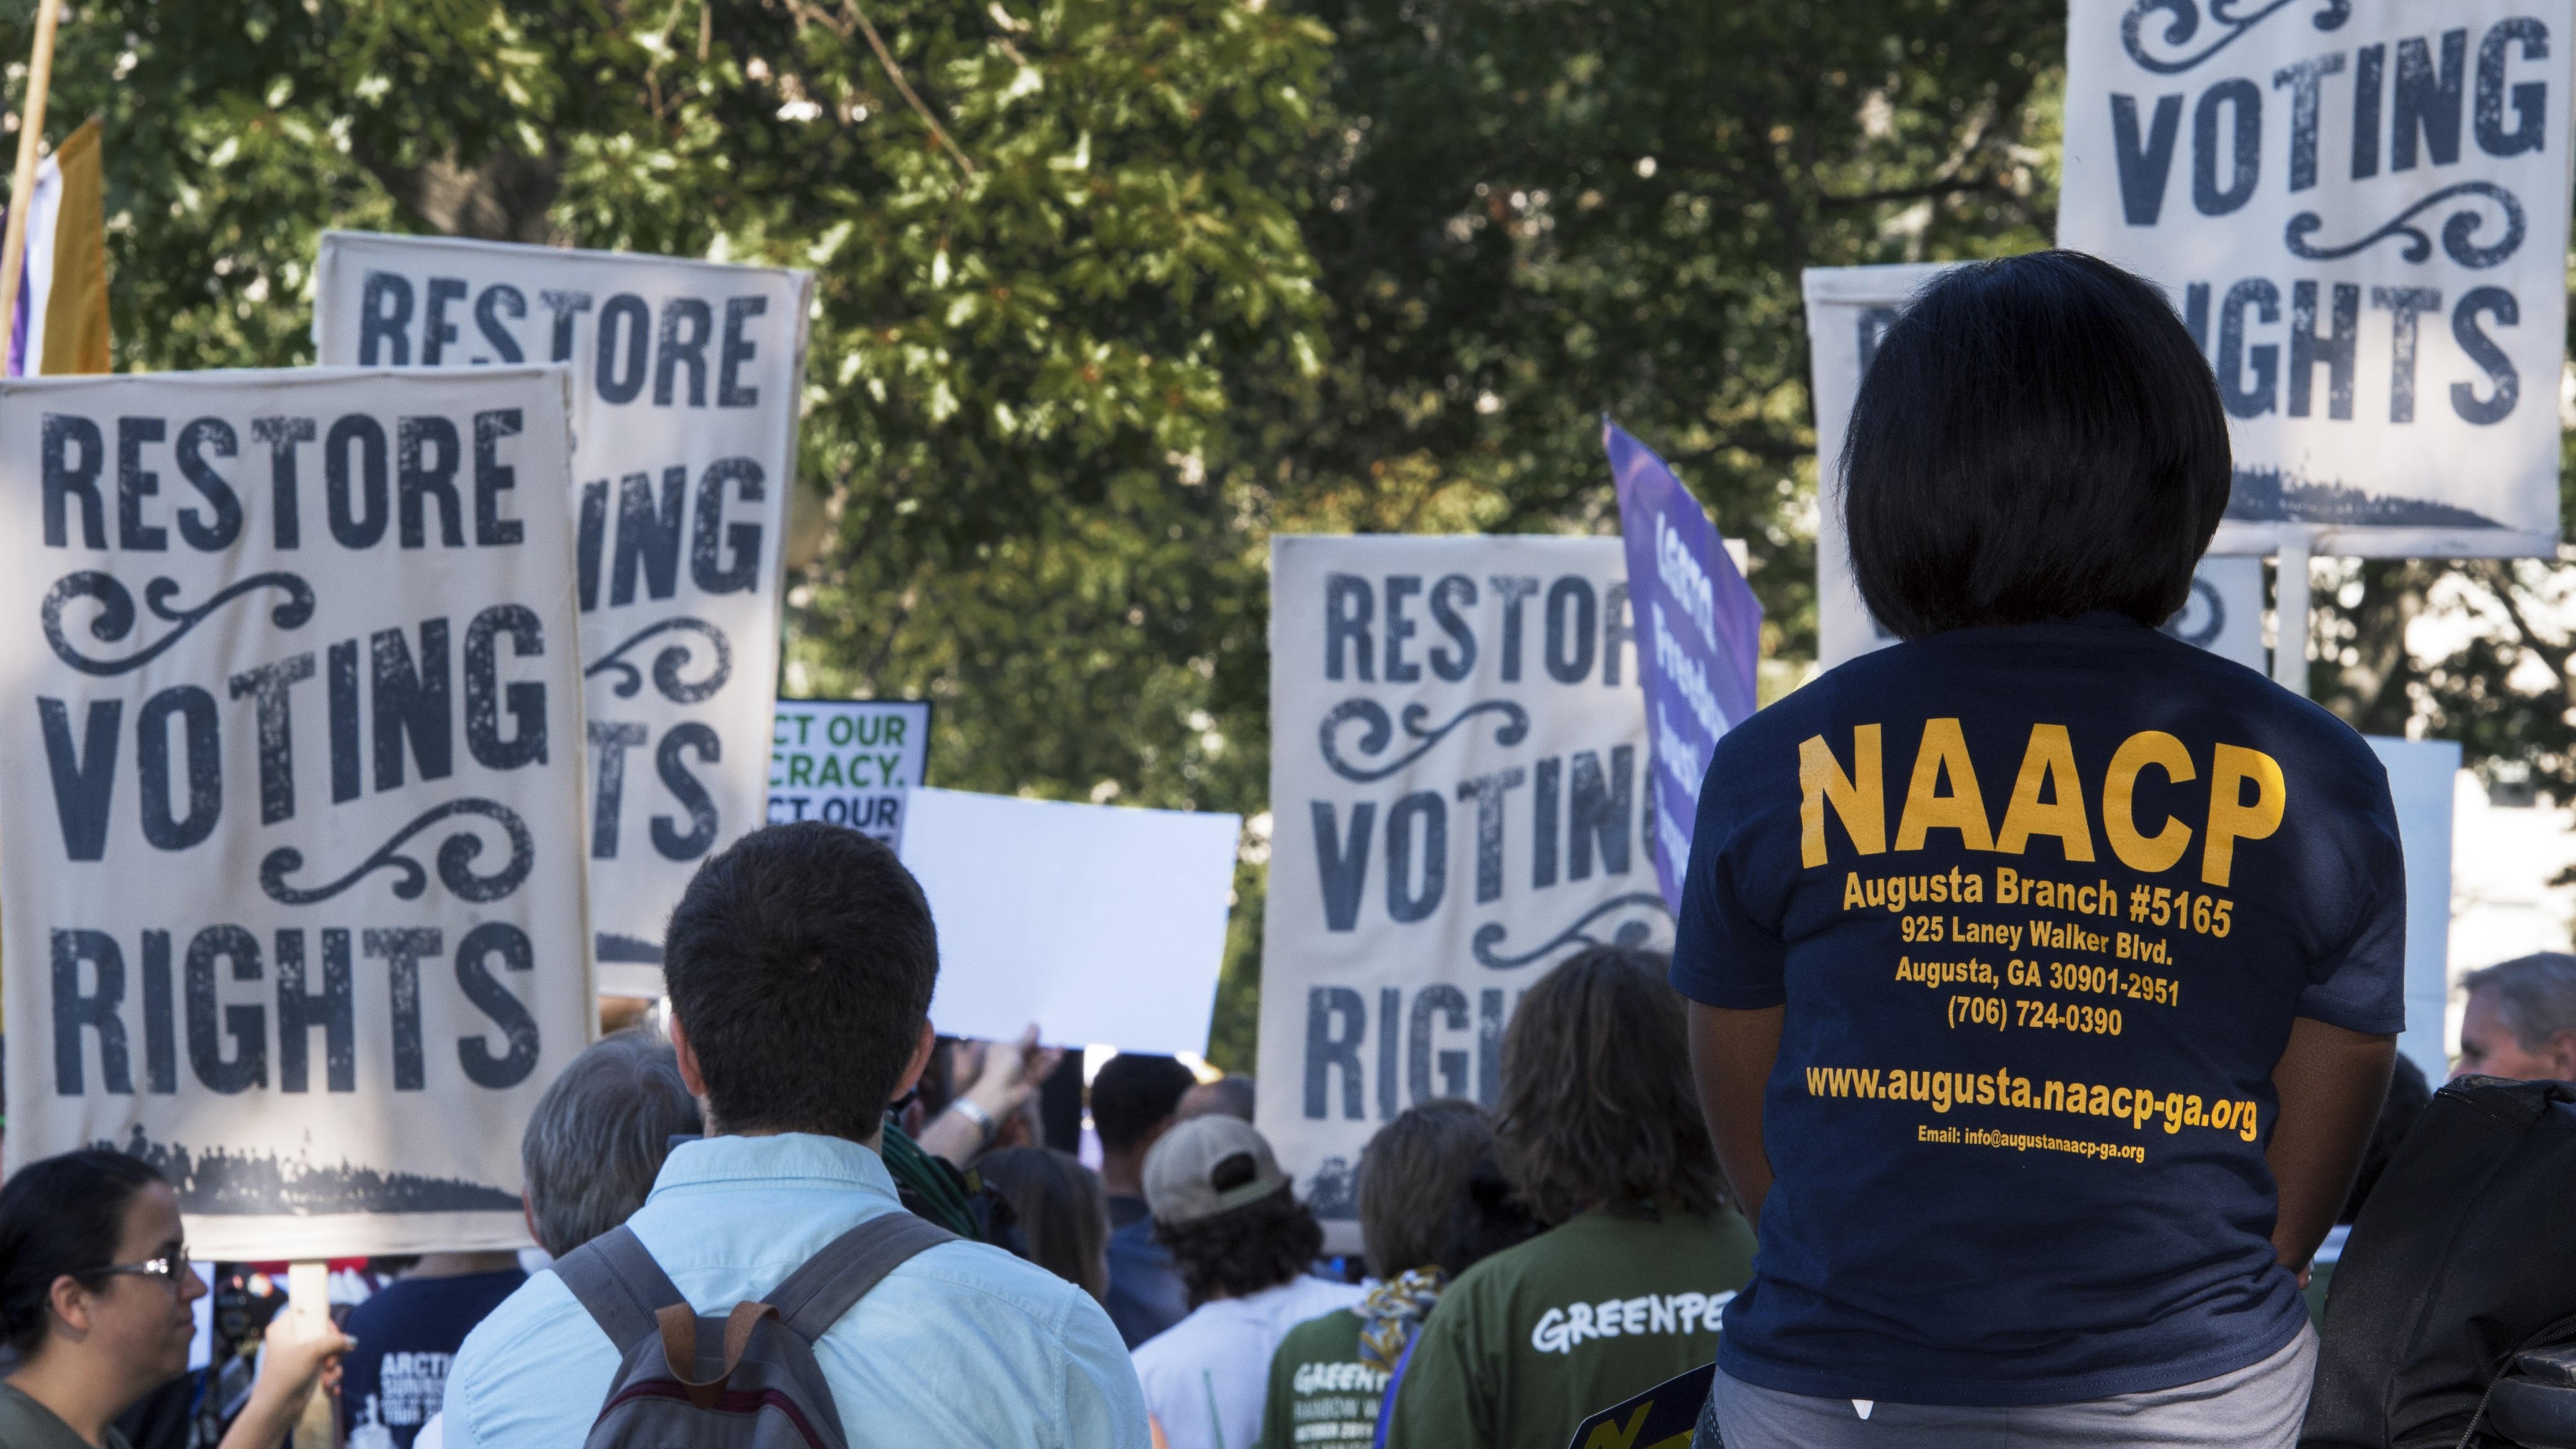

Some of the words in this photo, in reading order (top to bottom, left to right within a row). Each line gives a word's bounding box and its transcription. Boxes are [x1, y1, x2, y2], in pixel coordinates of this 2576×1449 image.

[2110, 17, 2549, 225] VOTING
[359, 269, 768, 408] RESTORE
[41, 408, 525, 551] RESTORE
[577, 456, 765, 613] ING
[37, 603, 548, 861] VOTING
[828, 715, 906, 746] OUR
[769, 752, 905, 787] CRACY.
[1798, 717, 2286, 888] NAACP
[823, 797, 898, 828] OUR
[1310, 745, 1655, 932] VOTIN
[1843, 865, 1983, 913] Augusta
[1996, 867, 2118, 917] Branch
[2129, 883, 2234, 939] #5165
[1901, 916, 1944, 943] 925
[1952, 917, 2022, 952] Laney
[2029, 920, 2110, 954] Walker
[2116, 932, 2173, 966] Blvd.
[51, 921, 540, 1095] RIGHTS
[1896, 956, 2000, 990] Augusta,
[2007, 960, 2042, 986] GA
[2049, 963, 2179, 1007] 30901-2951
[1948, 996, 2007, 1031] (706)
[2016, 1000, 2122, 1036] 724-0390
[1806, 1066, 2258, 1142] www.augusta.naacp-ga.org
[1918, 1125, 1960, 1144] Email:
[1965, 1127, 2145, 1163] info@augustanaacp-ga.org
[1531, 1289, 1738, 1355] GREENPE
[380, 1351, 457, 1377] ARCTI
